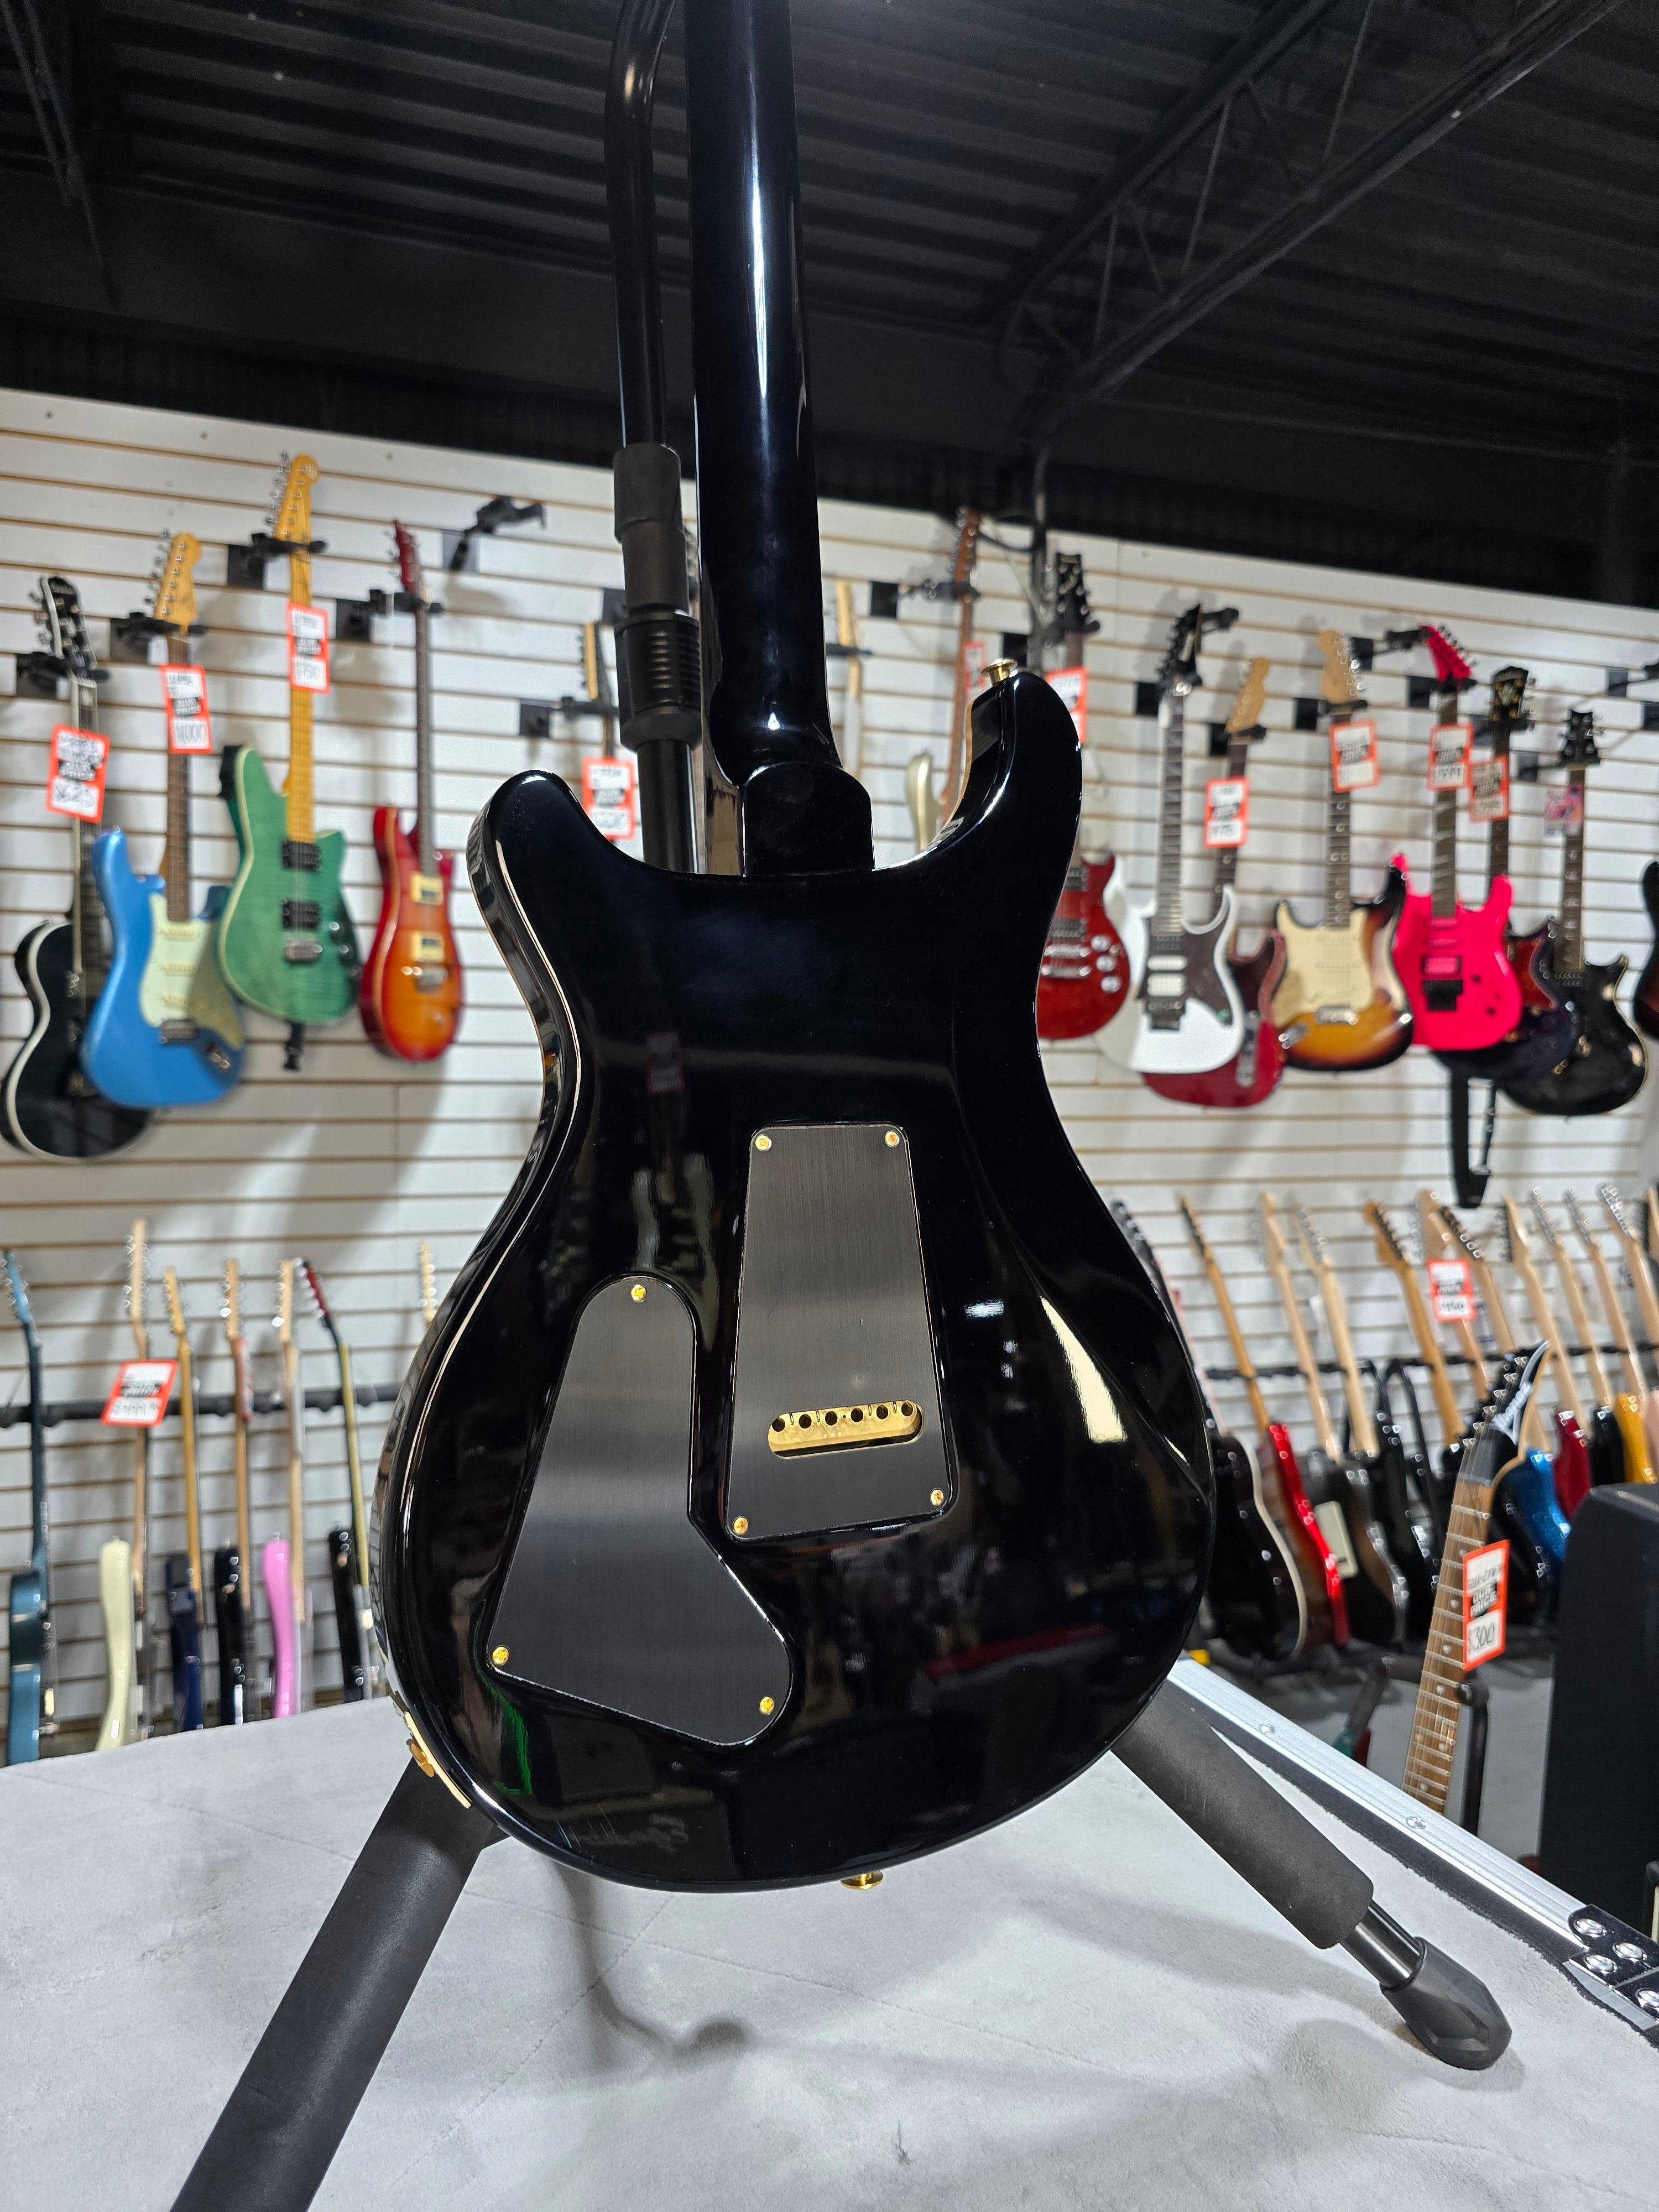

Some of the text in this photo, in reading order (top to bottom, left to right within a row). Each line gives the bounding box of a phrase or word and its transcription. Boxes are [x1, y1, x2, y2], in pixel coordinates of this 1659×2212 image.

[1471, 1590, 1499, 1618] PRICE
[1473, 1584, 1494, 1604] OUR
[1467, 1621, 1495, 1655] $300
